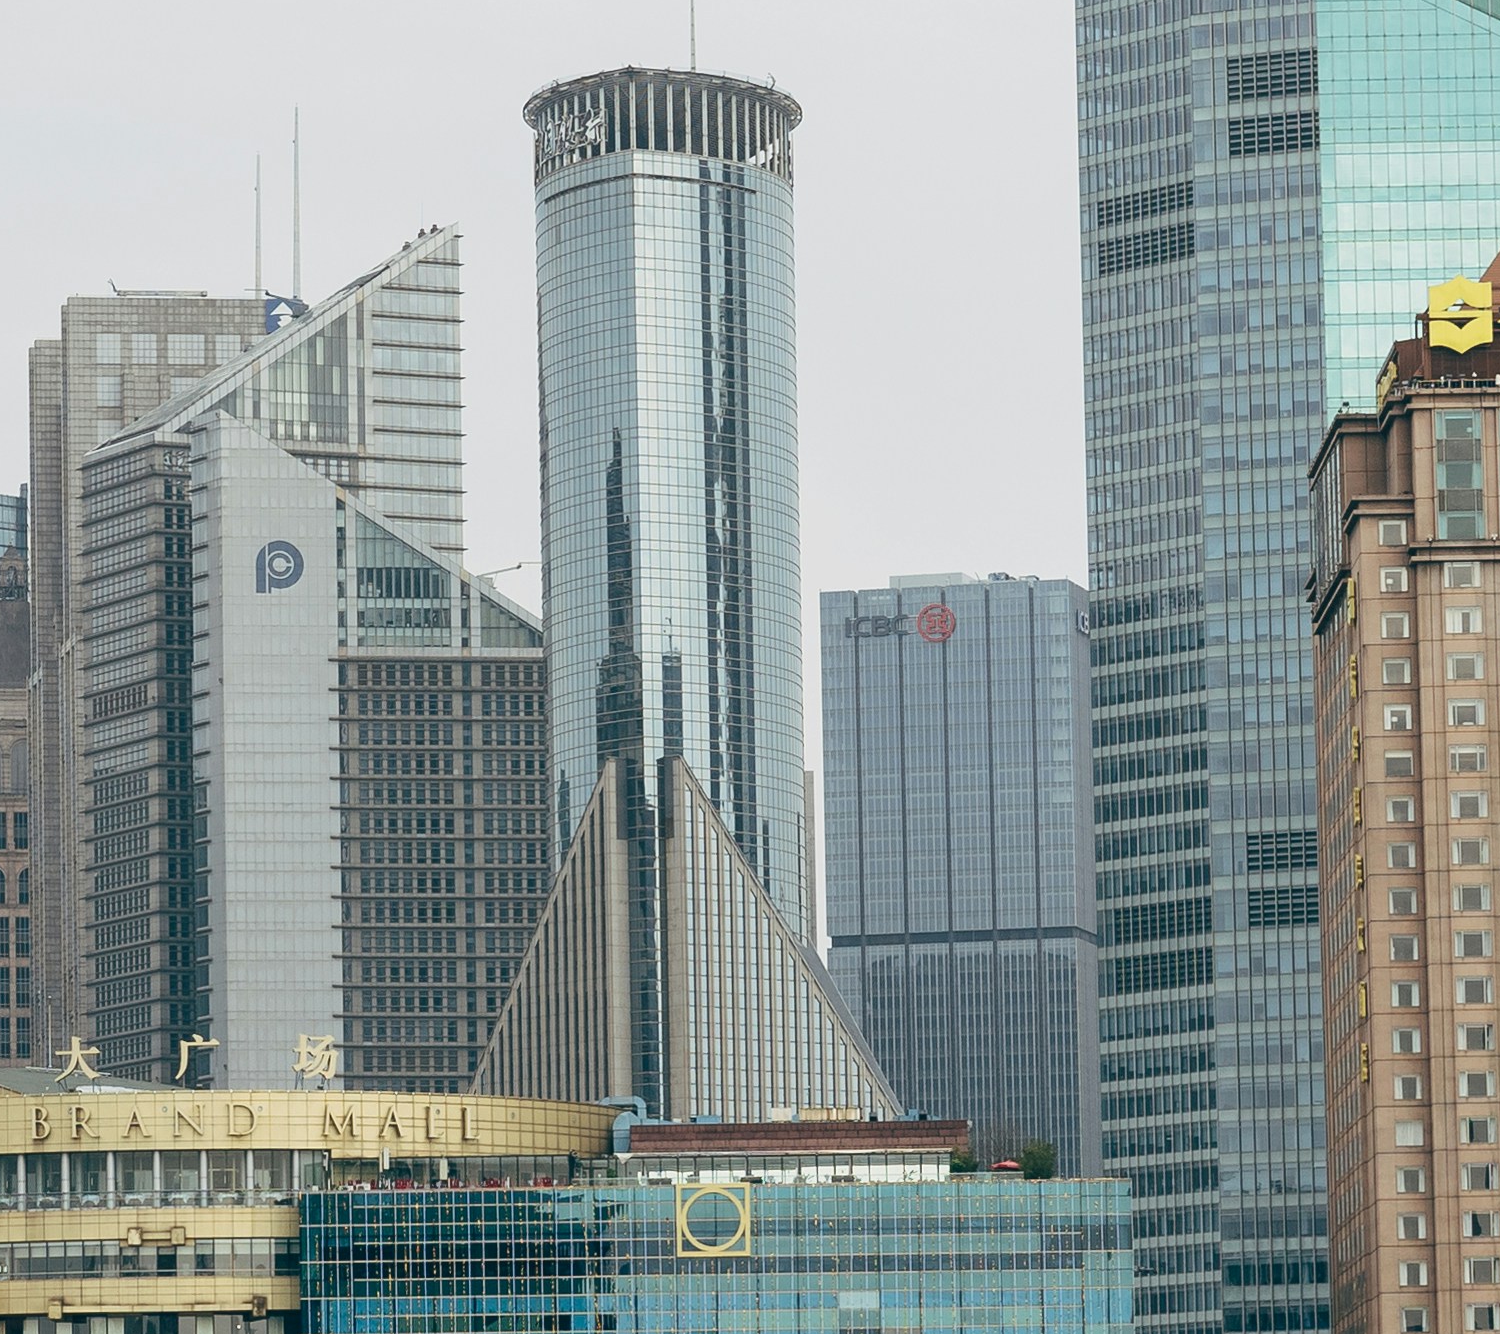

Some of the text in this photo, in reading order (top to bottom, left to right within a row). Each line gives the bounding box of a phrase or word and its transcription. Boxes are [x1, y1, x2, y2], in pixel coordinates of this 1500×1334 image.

[845, 613, 916, 638] ICBC
[30, 1103, 259, 1141] BRAND
[322, 1104, 482, 1141] MALL
